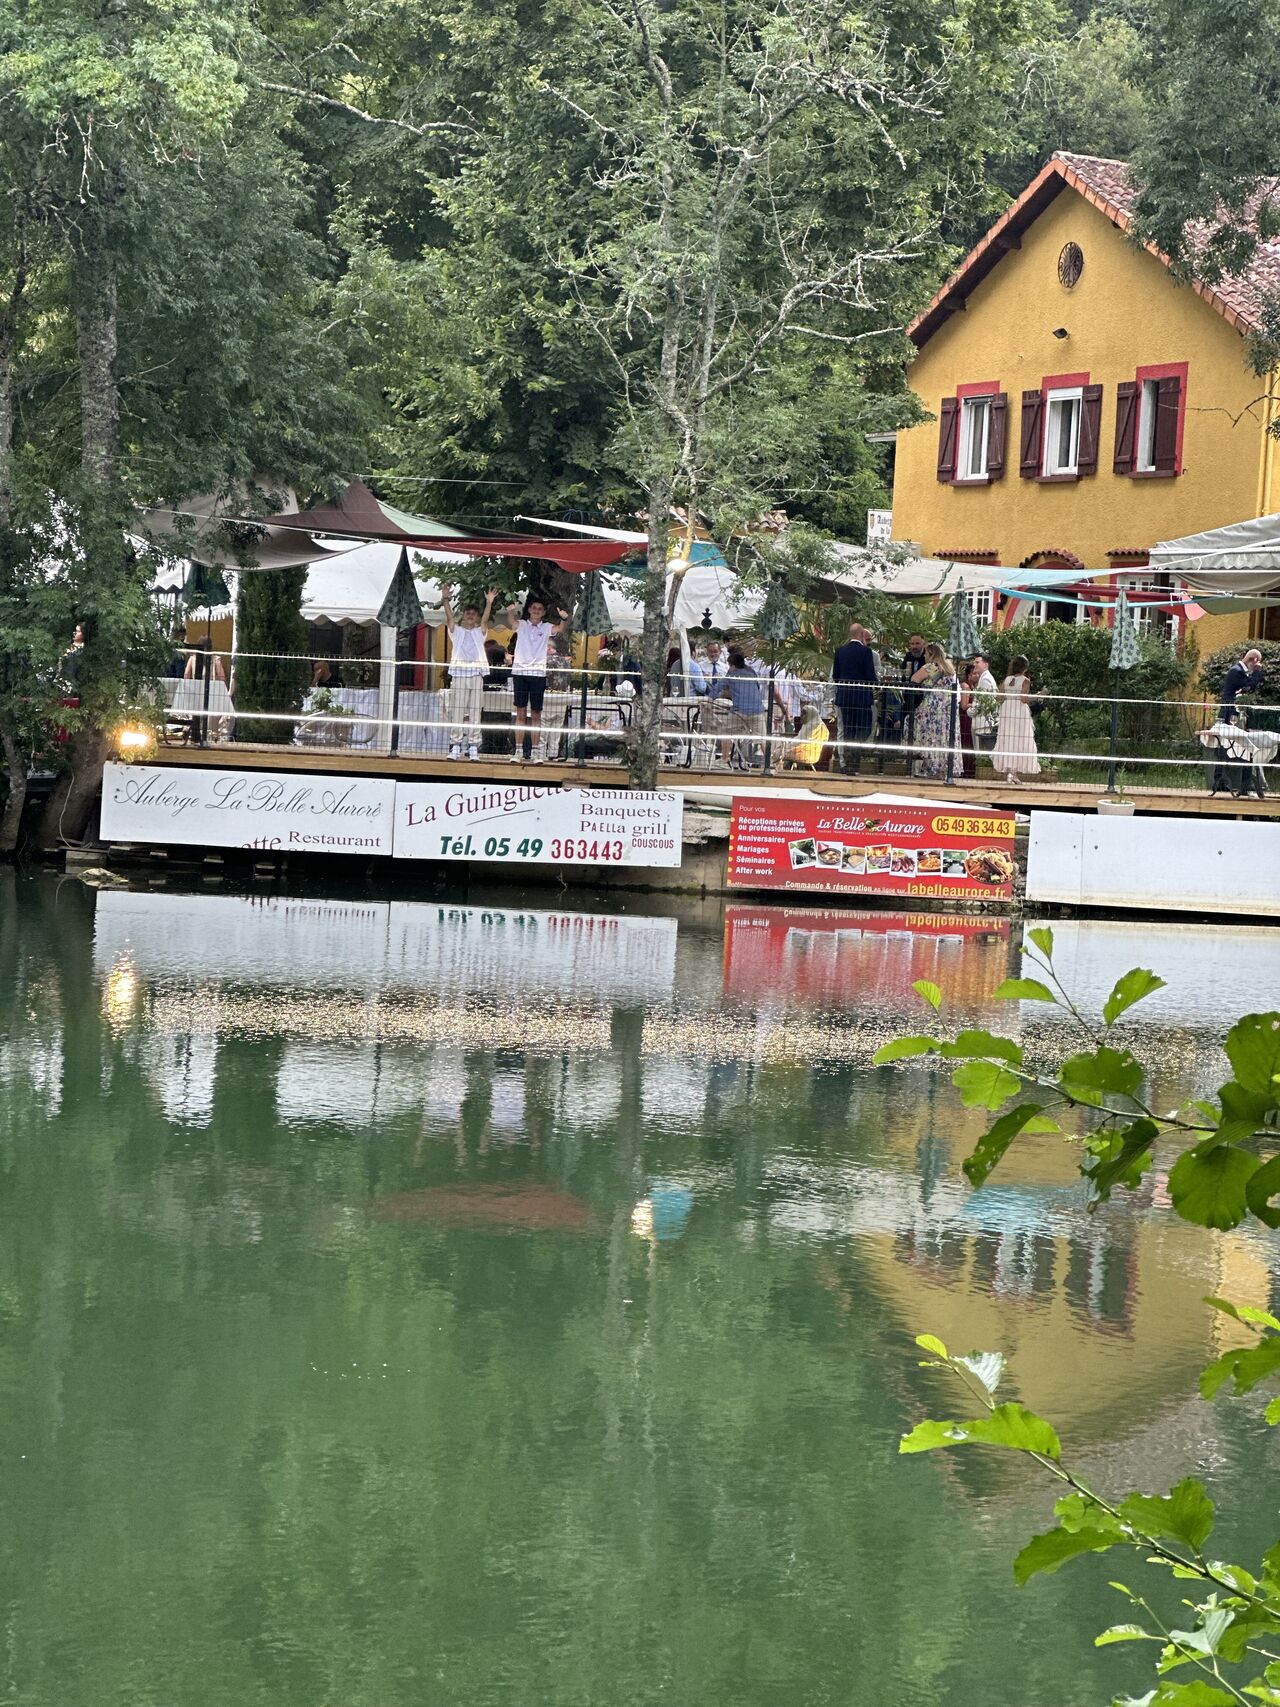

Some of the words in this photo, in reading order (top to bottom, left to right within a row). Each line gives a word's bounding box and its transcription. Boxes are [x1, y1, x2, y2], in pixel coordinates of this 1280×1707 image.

[114, 774, 200, 817] Auberge
[205, 777, 248, 810] La
[247, 779, 313, 813] Belle
[405, 802, 437, 827] La
[581, 803, 661, 819] Banquets
[739, 804, 753, 812] Pour
[631, 822, 668, 837] grill
[738, 816, 778, 827] Réceptions
[778, 818, 805, 828] privées
[748, 824, 807, 834] professionnelles
[816, 818, 832, 829] La
[831, 816, 867, 832] Belle
[875, 819, 926, 834] Aurore
[936, 818, 949, 832] 05
[951, 818, 965, 833] 49
[967, 819, 980, 834] 36
[981, 820, 995, 834] 34
[996, 821, 1010, 835] 43
[288, 830, 381, 848] Restaurant
[631, 837, 675, 849] COUSCOUS
[737, 834, 786, 844] Anniversaires
[440, 834, 477, 856] Tél.
[484, 837, 511, 857] 05
[516, 838, 544, 858] 49
[551, 838, 624, 861] 363443
[736, 844, 770, 855] Mariages
[736, 855, 776, 865] Séminaires
[735, 866, 754, 875] After
[754, 867, 773, 876] work
[785, 880, 824, 889] Commande
[825, 882, 831, 890] &
[832, 882, 873, 892] réservation
[907, 882, 1006, 899] labelleaurore.fr
